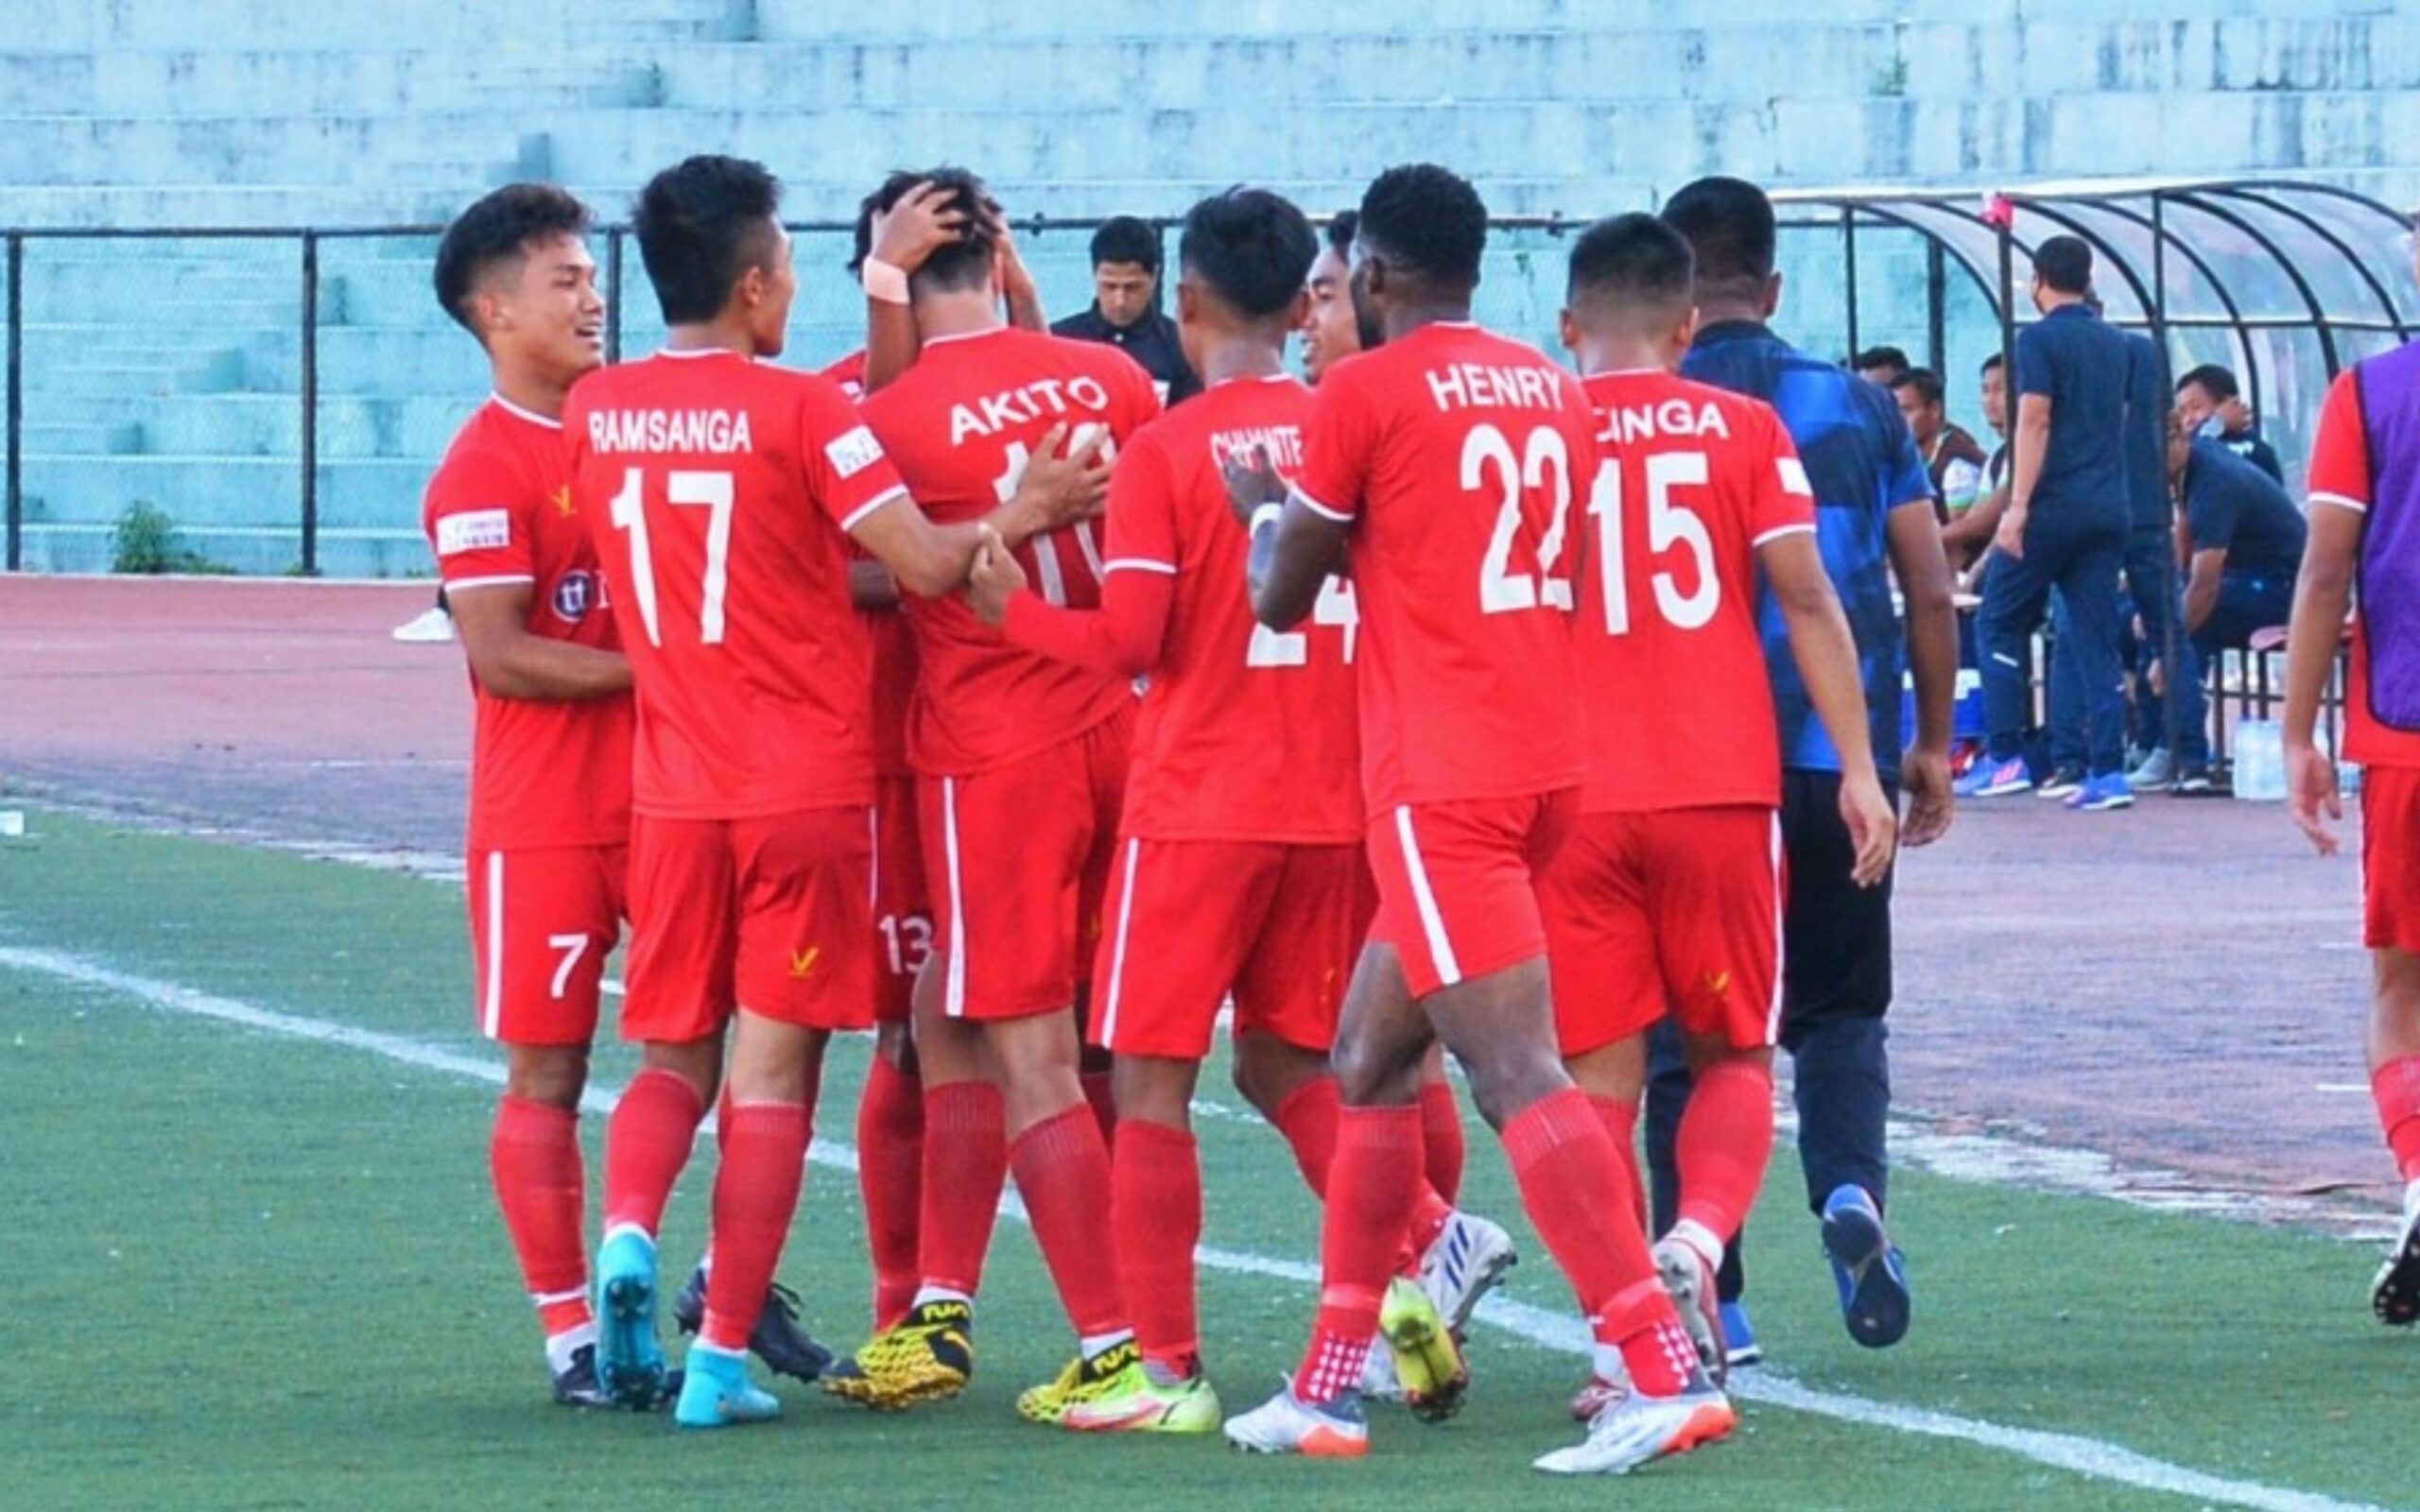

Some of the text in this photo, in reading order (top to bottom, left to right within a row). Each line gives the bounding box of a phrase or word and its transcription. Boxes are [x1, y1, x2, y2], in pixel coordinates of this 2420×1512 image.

[950, 376, 1109, 446] AKITO
[1426, 363, 1564, 413] HENRY
[588, 408, 753, 455] RAMSANGA
[1460, 422, 1573, 614] 22
[1587, 450, 1722, 637] 15
[610, 467, 735, 650] 17
[548, 933, 589, 999] 7
[878, 914, 933, 975] 13
